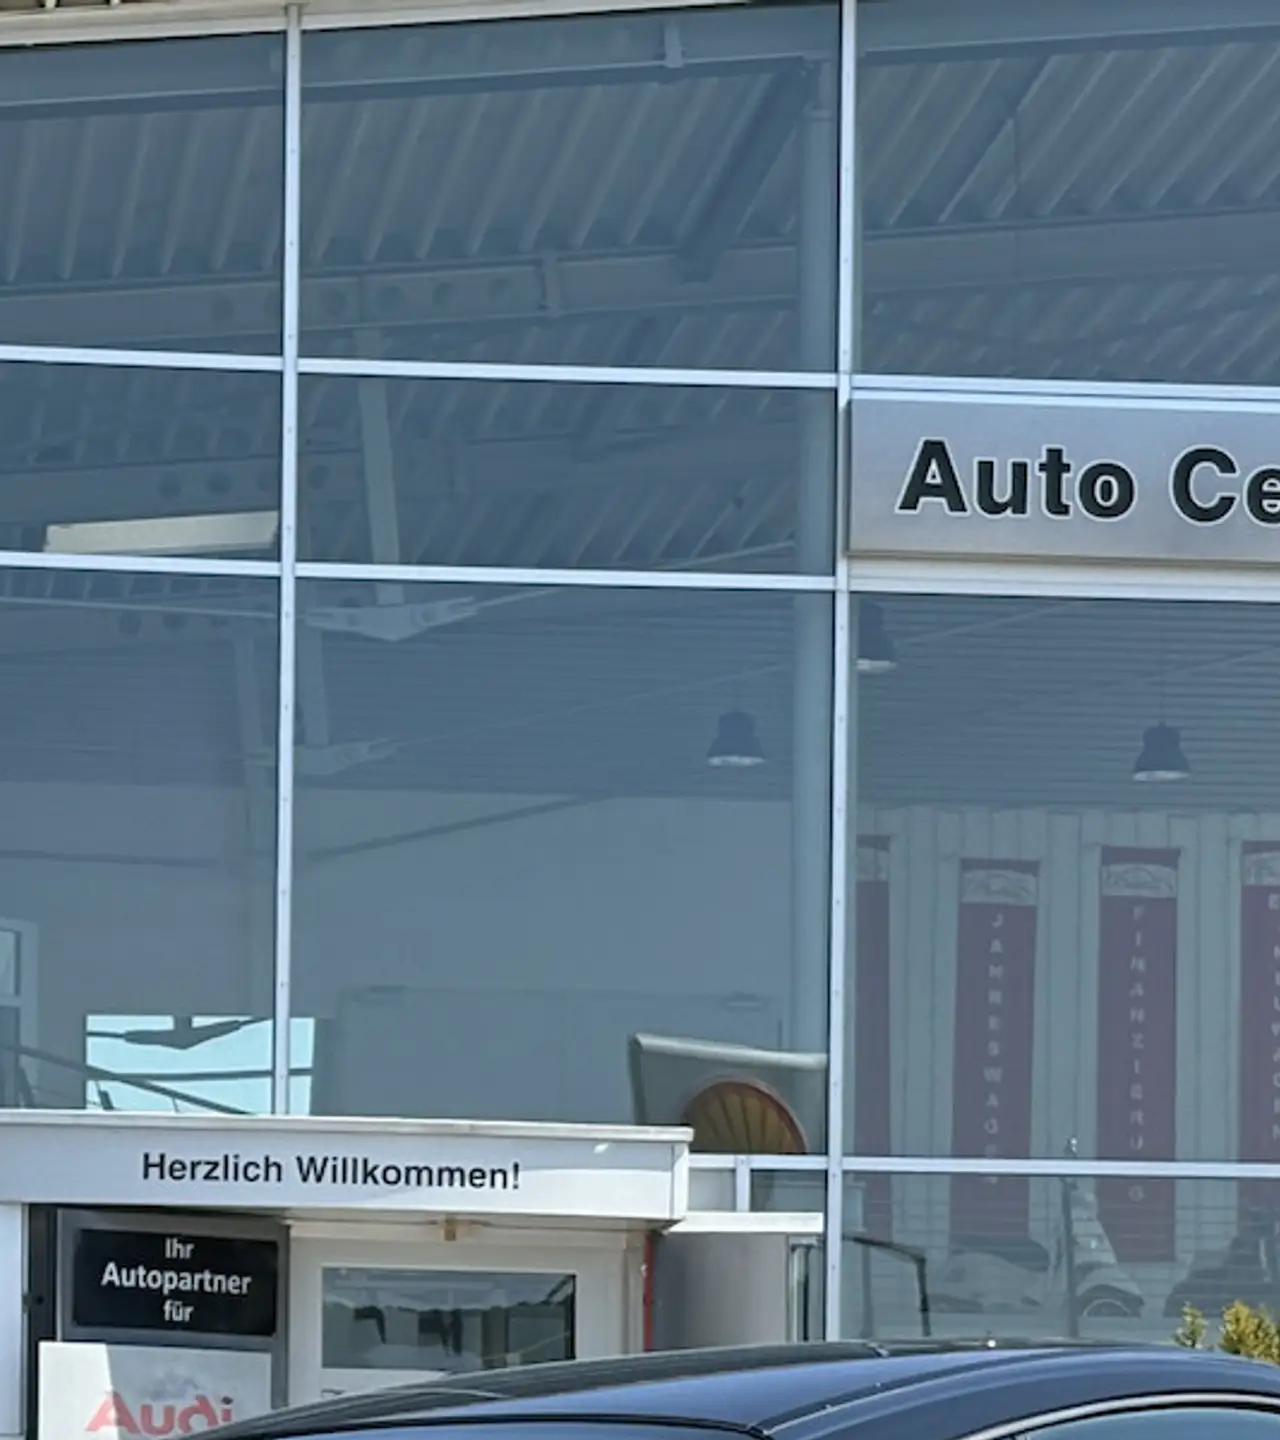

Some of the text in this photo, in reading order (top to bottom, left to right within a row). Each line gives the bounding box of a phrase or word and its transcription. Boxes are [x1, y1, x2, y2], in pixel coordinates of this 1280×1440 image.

[897, 438, 1138, 523] Auto
[1128, 906, 1146, 1202] FINANZIERUG
[142, 1152, 521, 1191] Herzlich Willkommen!
[164, 1237, 195, 1261] Ihr
[101, 1262, 252, 1298] Autopartner
[162, 1300, 195, 1324] für
[85, 1391, 234, 1437] Audi
